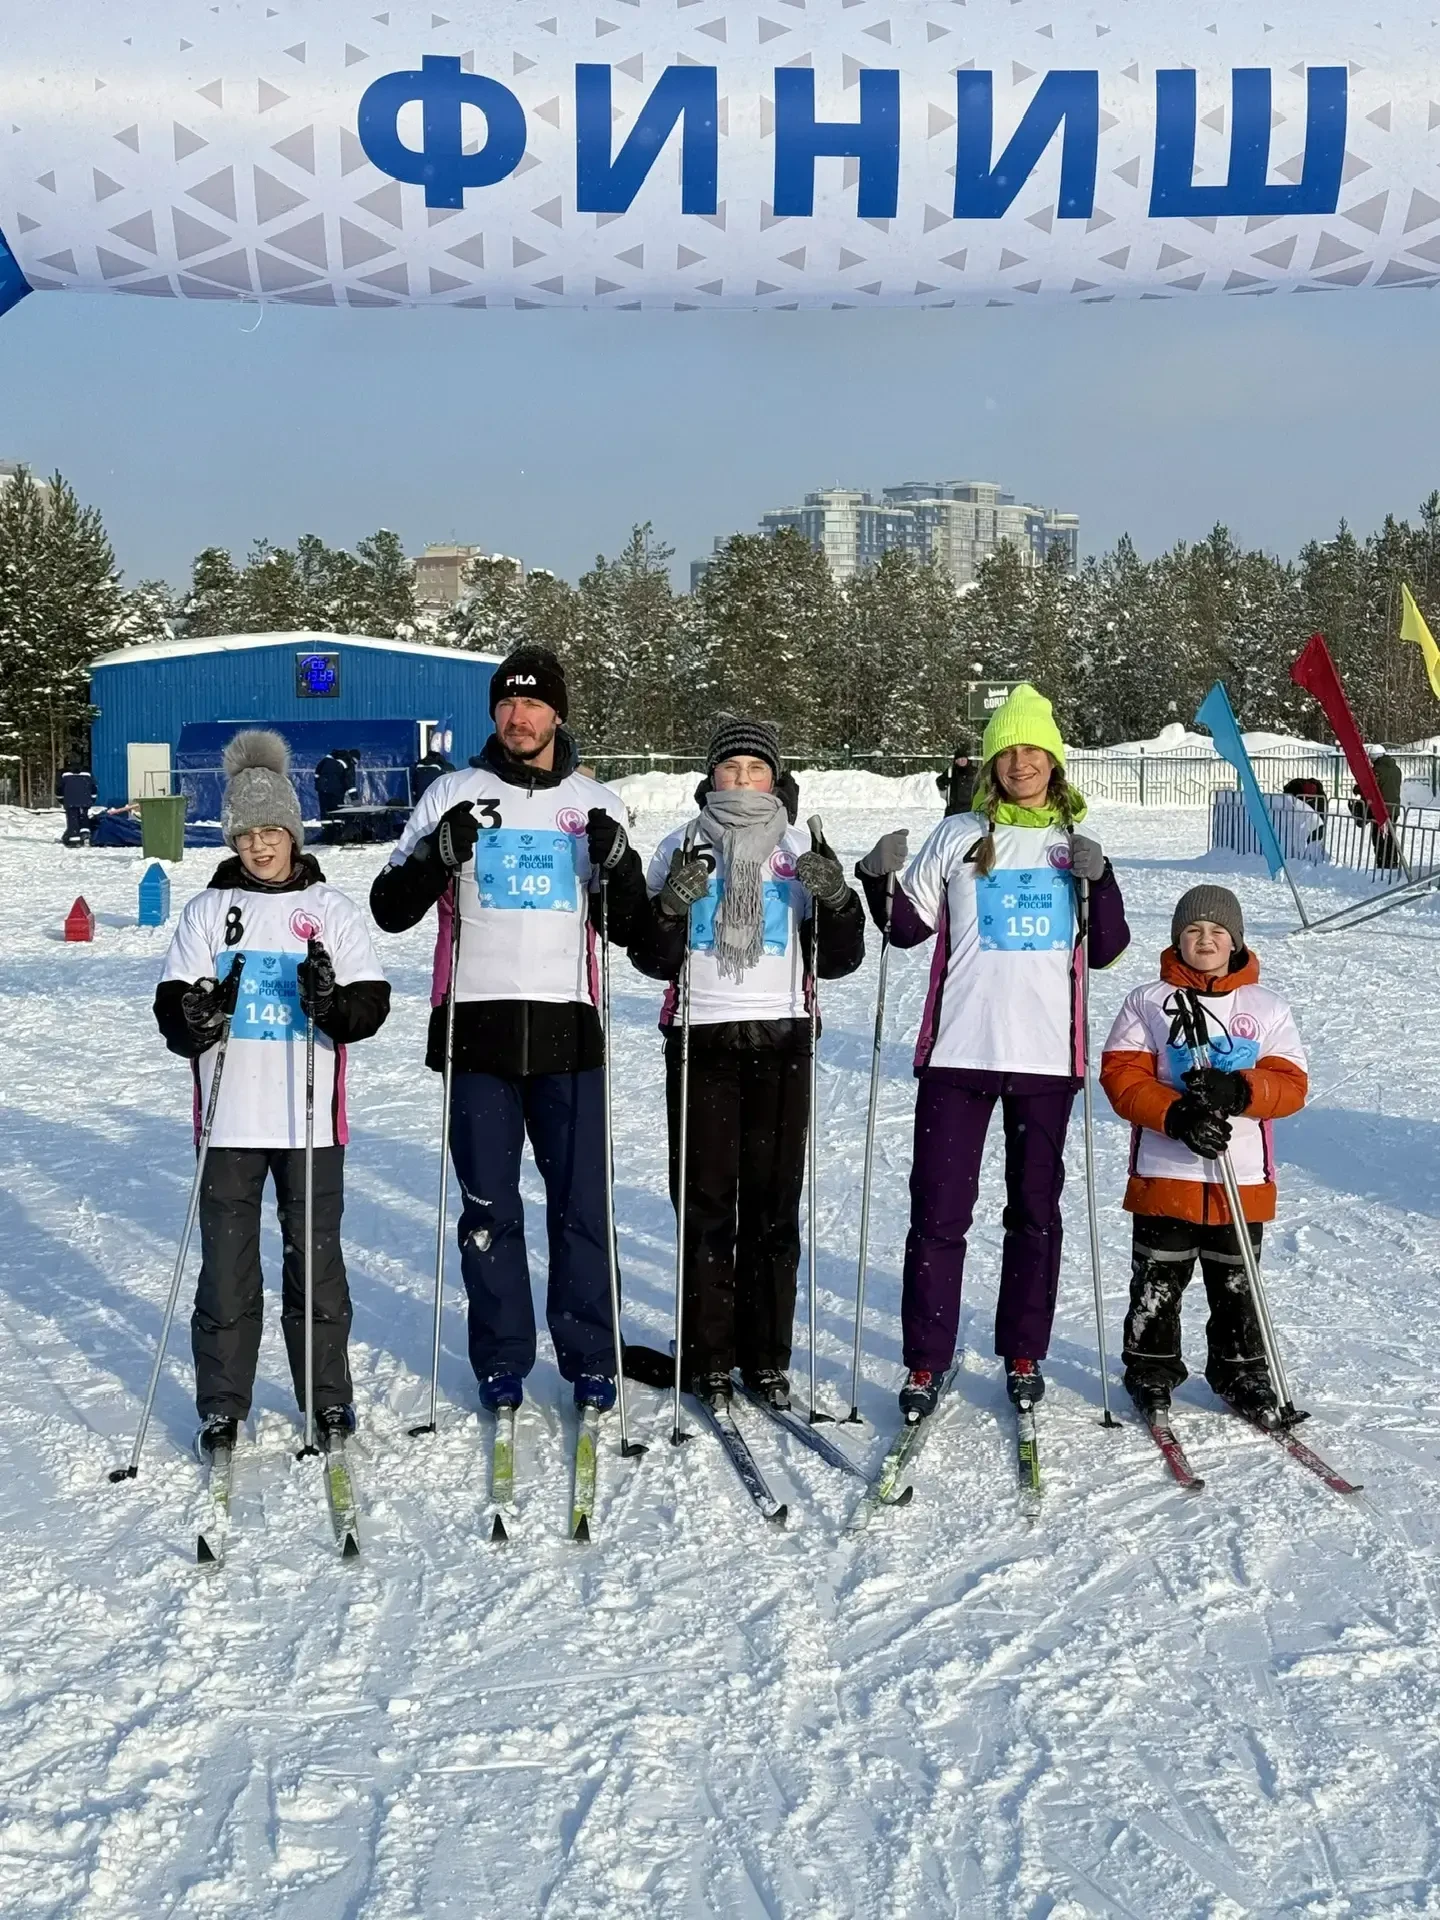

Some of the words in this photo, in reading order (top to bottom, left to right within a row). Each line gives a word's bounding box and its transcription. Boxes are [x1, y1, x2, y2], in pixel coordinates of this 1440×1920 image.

[358, 54, 1348, 219] ФИНИШ
[506, 674, 537, 686] FILA
[477, 798, 503, 834] 3
[519, 854, 553, 862] ЛЫЖНЯ
[518, 861, 553, 869] РОССИИ
[507, 874, 552, 896] 149
[1018, 893, 1052, 901] ЛЫЖНЯ
[1018, 901, 1052, 909] РОССИИ
[225, 906, 244, 946] 8
[1007, 916, 1051, 937] 150
[259, 979, 297, 989] ЛЫЖНЯ
[259, 988, 297, 997] РОССИИ
[245, 1002, 293, 1026] 148
